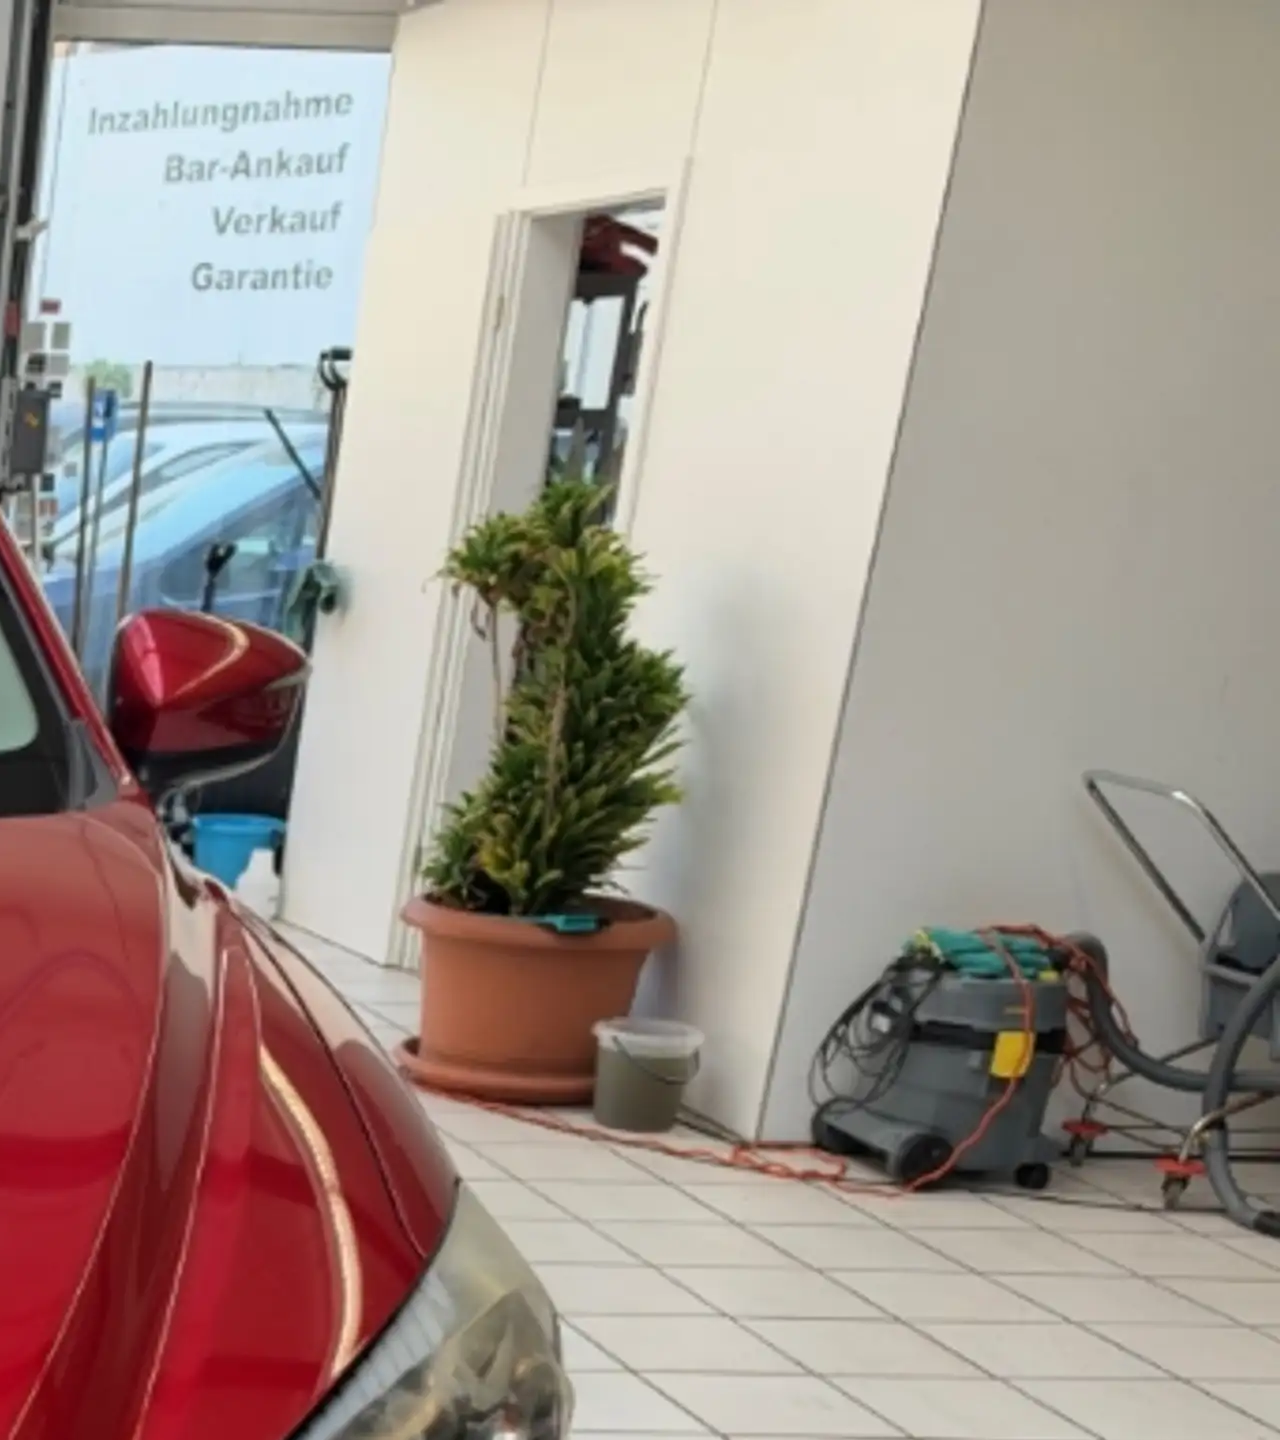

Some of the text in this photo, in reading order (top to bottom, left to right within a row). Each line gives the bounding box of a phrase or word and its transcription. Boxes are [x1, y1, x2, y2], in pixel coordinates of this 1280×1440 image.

[87, 90, 355, 136] Inzahlungnahme
[163, 142, 351, 185] Bar-Ankauf
[212, 200, 343, 236] Verkauf
[190, 260, 334, 292] Garantie
